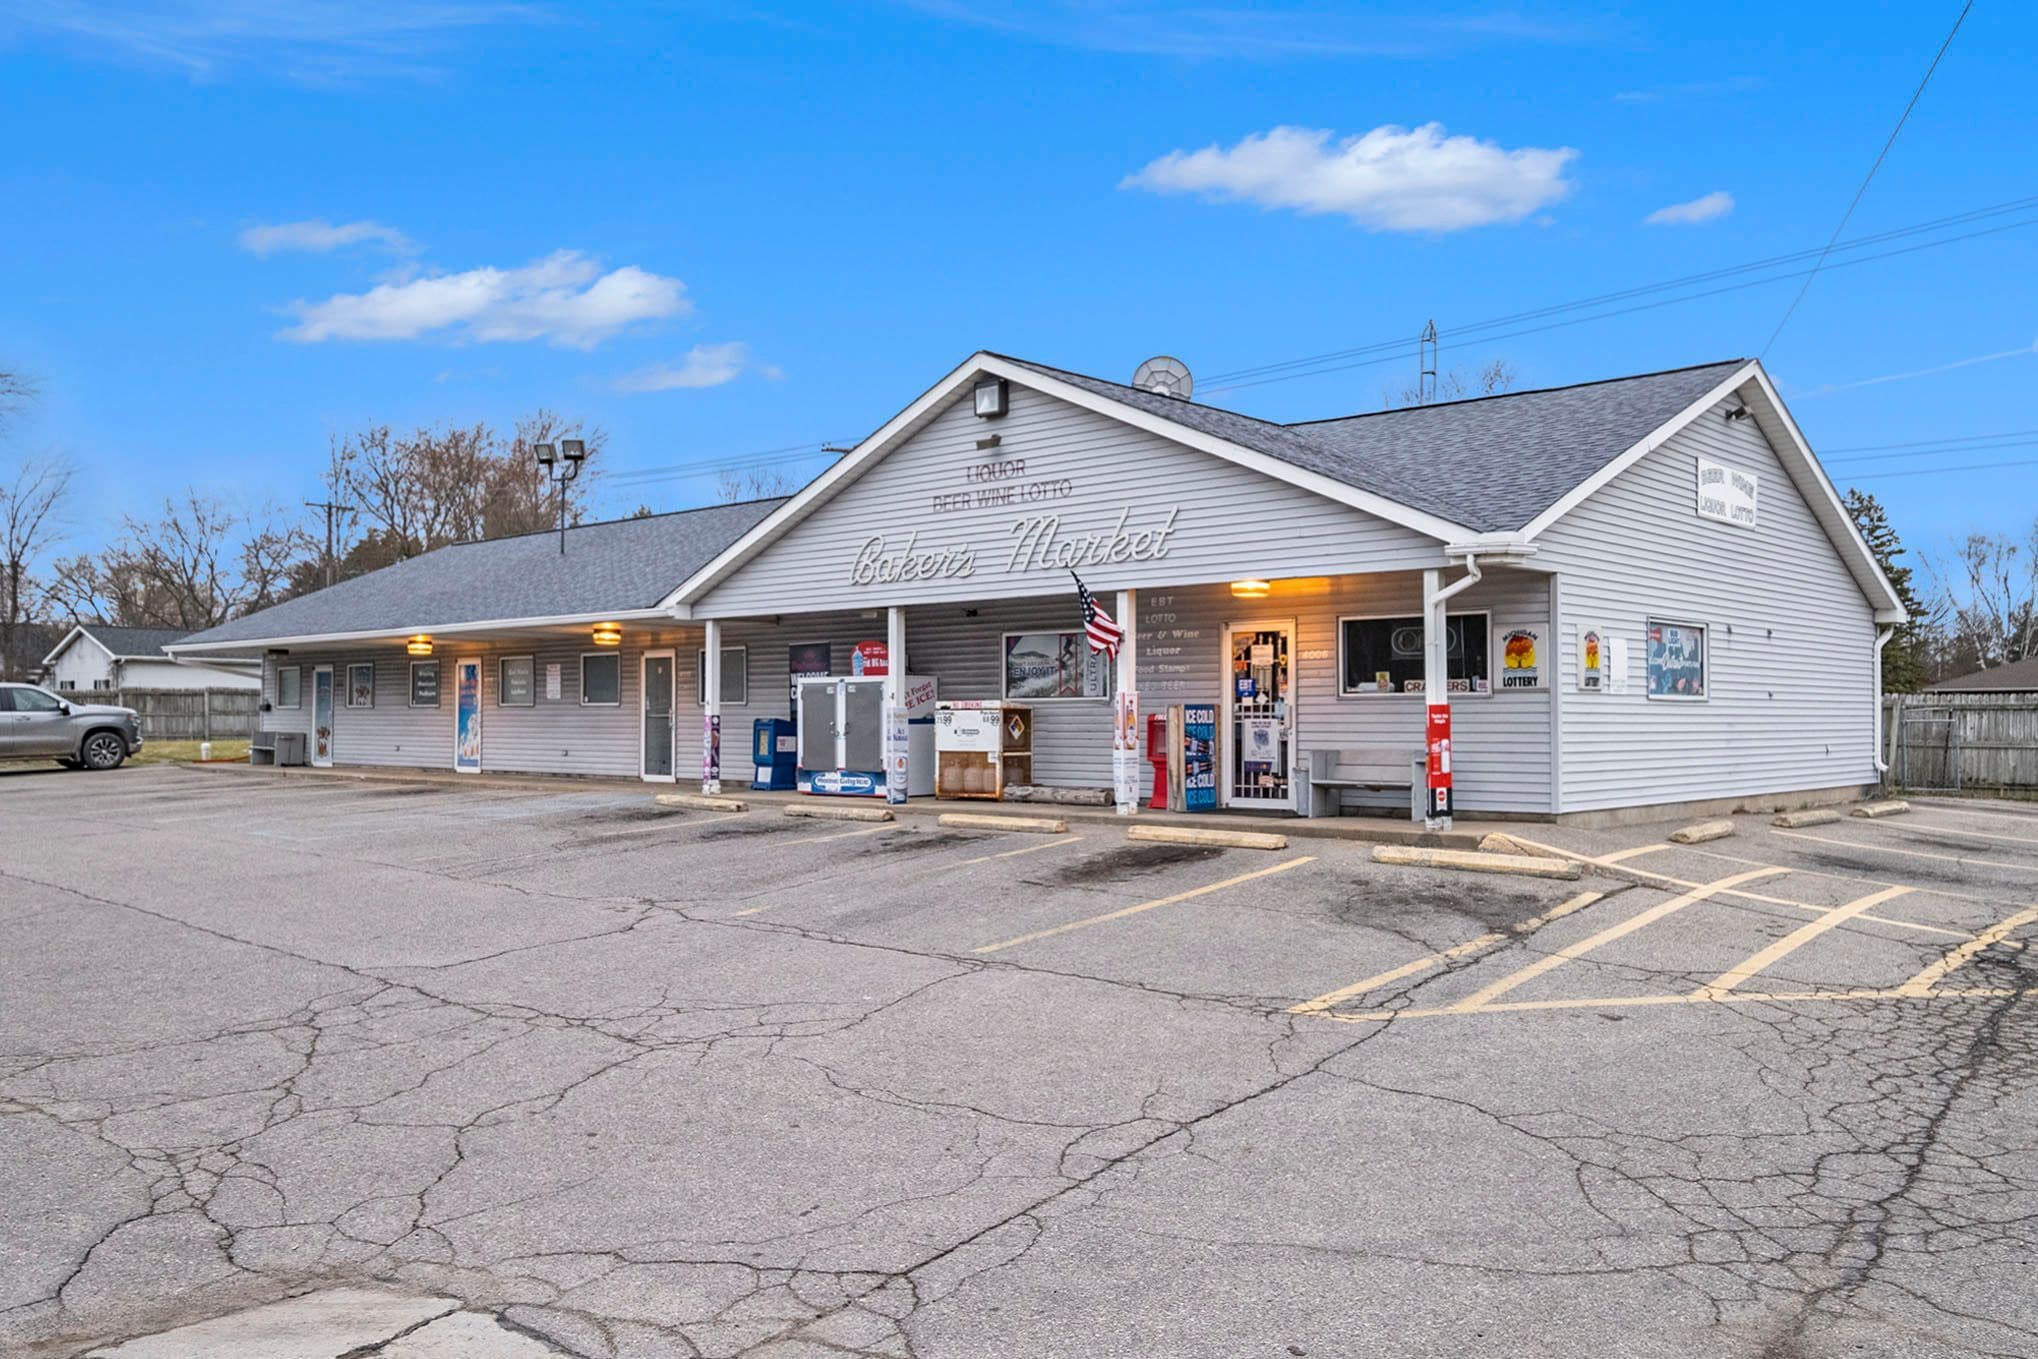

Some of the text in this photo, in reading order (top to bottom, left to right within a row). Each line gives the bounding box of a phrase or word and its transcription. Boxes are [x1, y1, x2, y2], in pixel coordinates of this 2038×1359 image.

[967, 459, 1025, 482] LIQUOR
[1701, 468, 1724, 486] BEER
[933, 479, 1072, 512] BEER WINE LOTTO
[850, 505, 1180, 585] Baker's Market
[1151, 596, 1174, 607] EBT
[1145, 613, 1177, 624] LOTTO
[1157, 630, 1167, 640] &
[1172, 629, 1200, 639] Wine
[1146, 645, 1181, 656] Liquor
[1014, 666, 1043, 676] ENJOY
[1088, 654, 1097, 692] ULTRA
[1406, 680, 1468, 692] CRAERS
[1502, 676, 1539, 687] LOTTERY
[1185, 709, 1214, 724] ICE COLD
[1197, 773, 1215, 787] COLD
